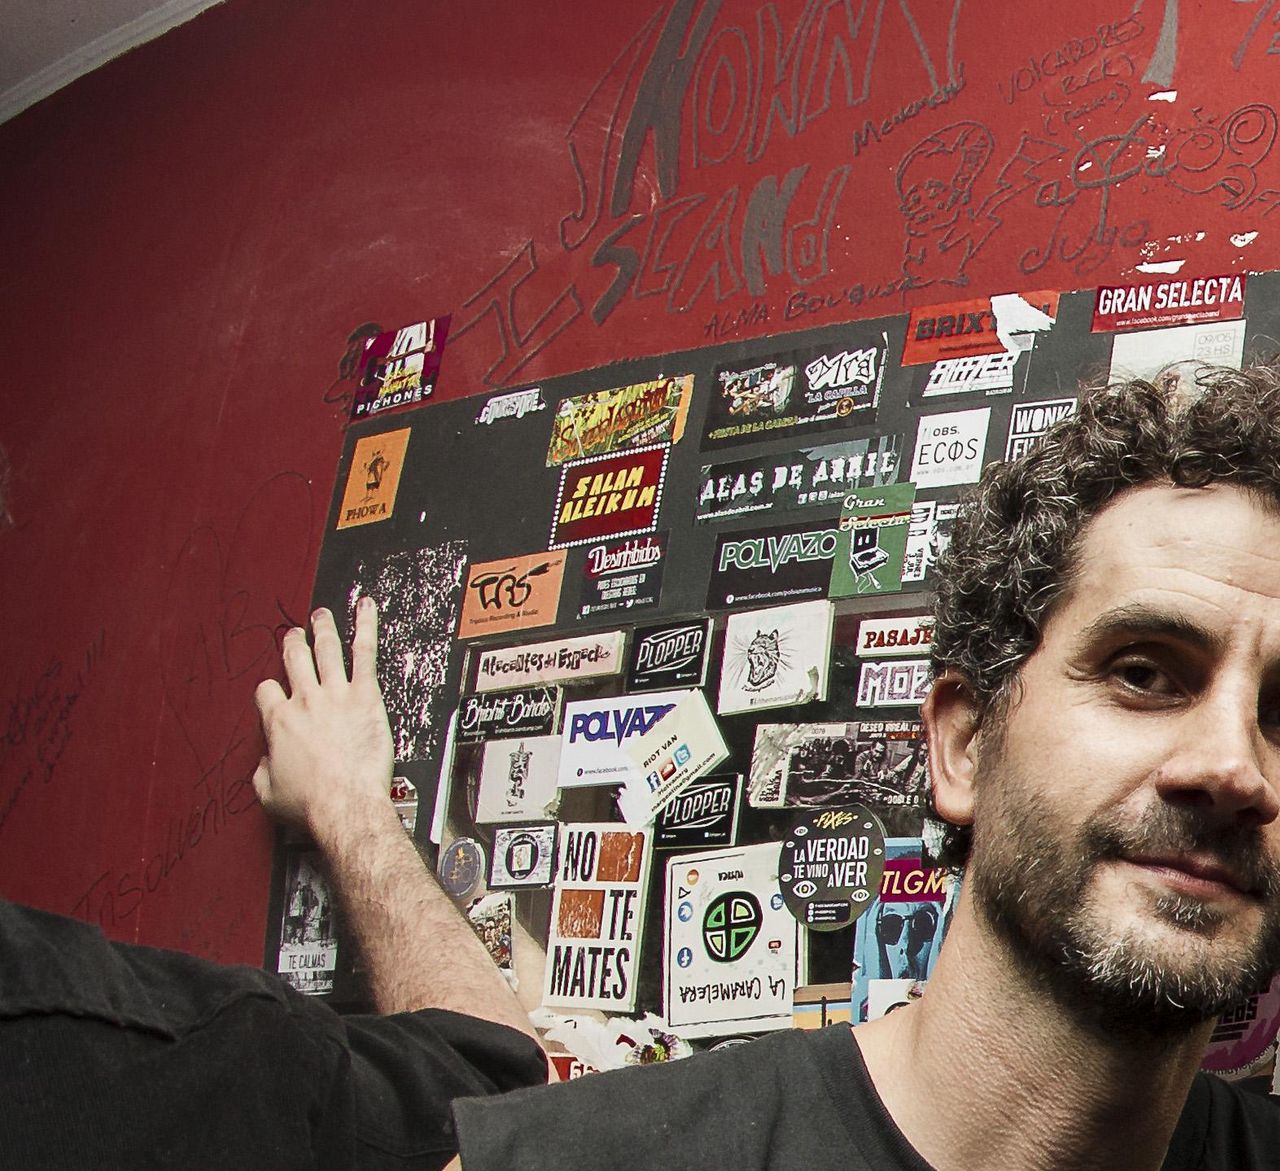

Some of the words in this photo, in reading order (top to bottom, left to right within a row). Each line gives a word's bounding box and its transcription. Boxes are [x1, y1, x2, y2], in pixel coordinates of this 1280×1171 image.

[1098, 284, 1153, 315] GRAN
[1154, 276, 1243, 309] SELECTA
[356, 384, 434, 415] PICHONES
[572, 465, 645, 499] SALAM
[700, 470, 764, 506] ALAS
[772, 464, 804, 494] DE
[559, 485, 657, 524] ALEIKUM
[843, 494, 886, 511] Gran
[718, 529, 838, 575] POLVAZO
[637, 629, 703, 672] PLOPPER
[643, 748, 662, 769] RIOT
[661, 734, 680, 751] VAN
[662, 787, 732, 826] PLOPPER
[563, 831, 597, 882] NO
[793, 849, 806, 864] LA
[806, 835, 870, 862] VERDAD
[793, 864, 805, 879] TE
[805, 863, 829, 879] VINO
[835, 861, 867, 888] VER
[608, 889, 638, 941] TE
[287, 954, 297, 970] TE
[298, 952, 327, 970] CALMAS
[550, 945, 630, 1000] MATES
[678, 977, 762, 1004] CARAMELERA
[768, 974, 786, 1001] LA
